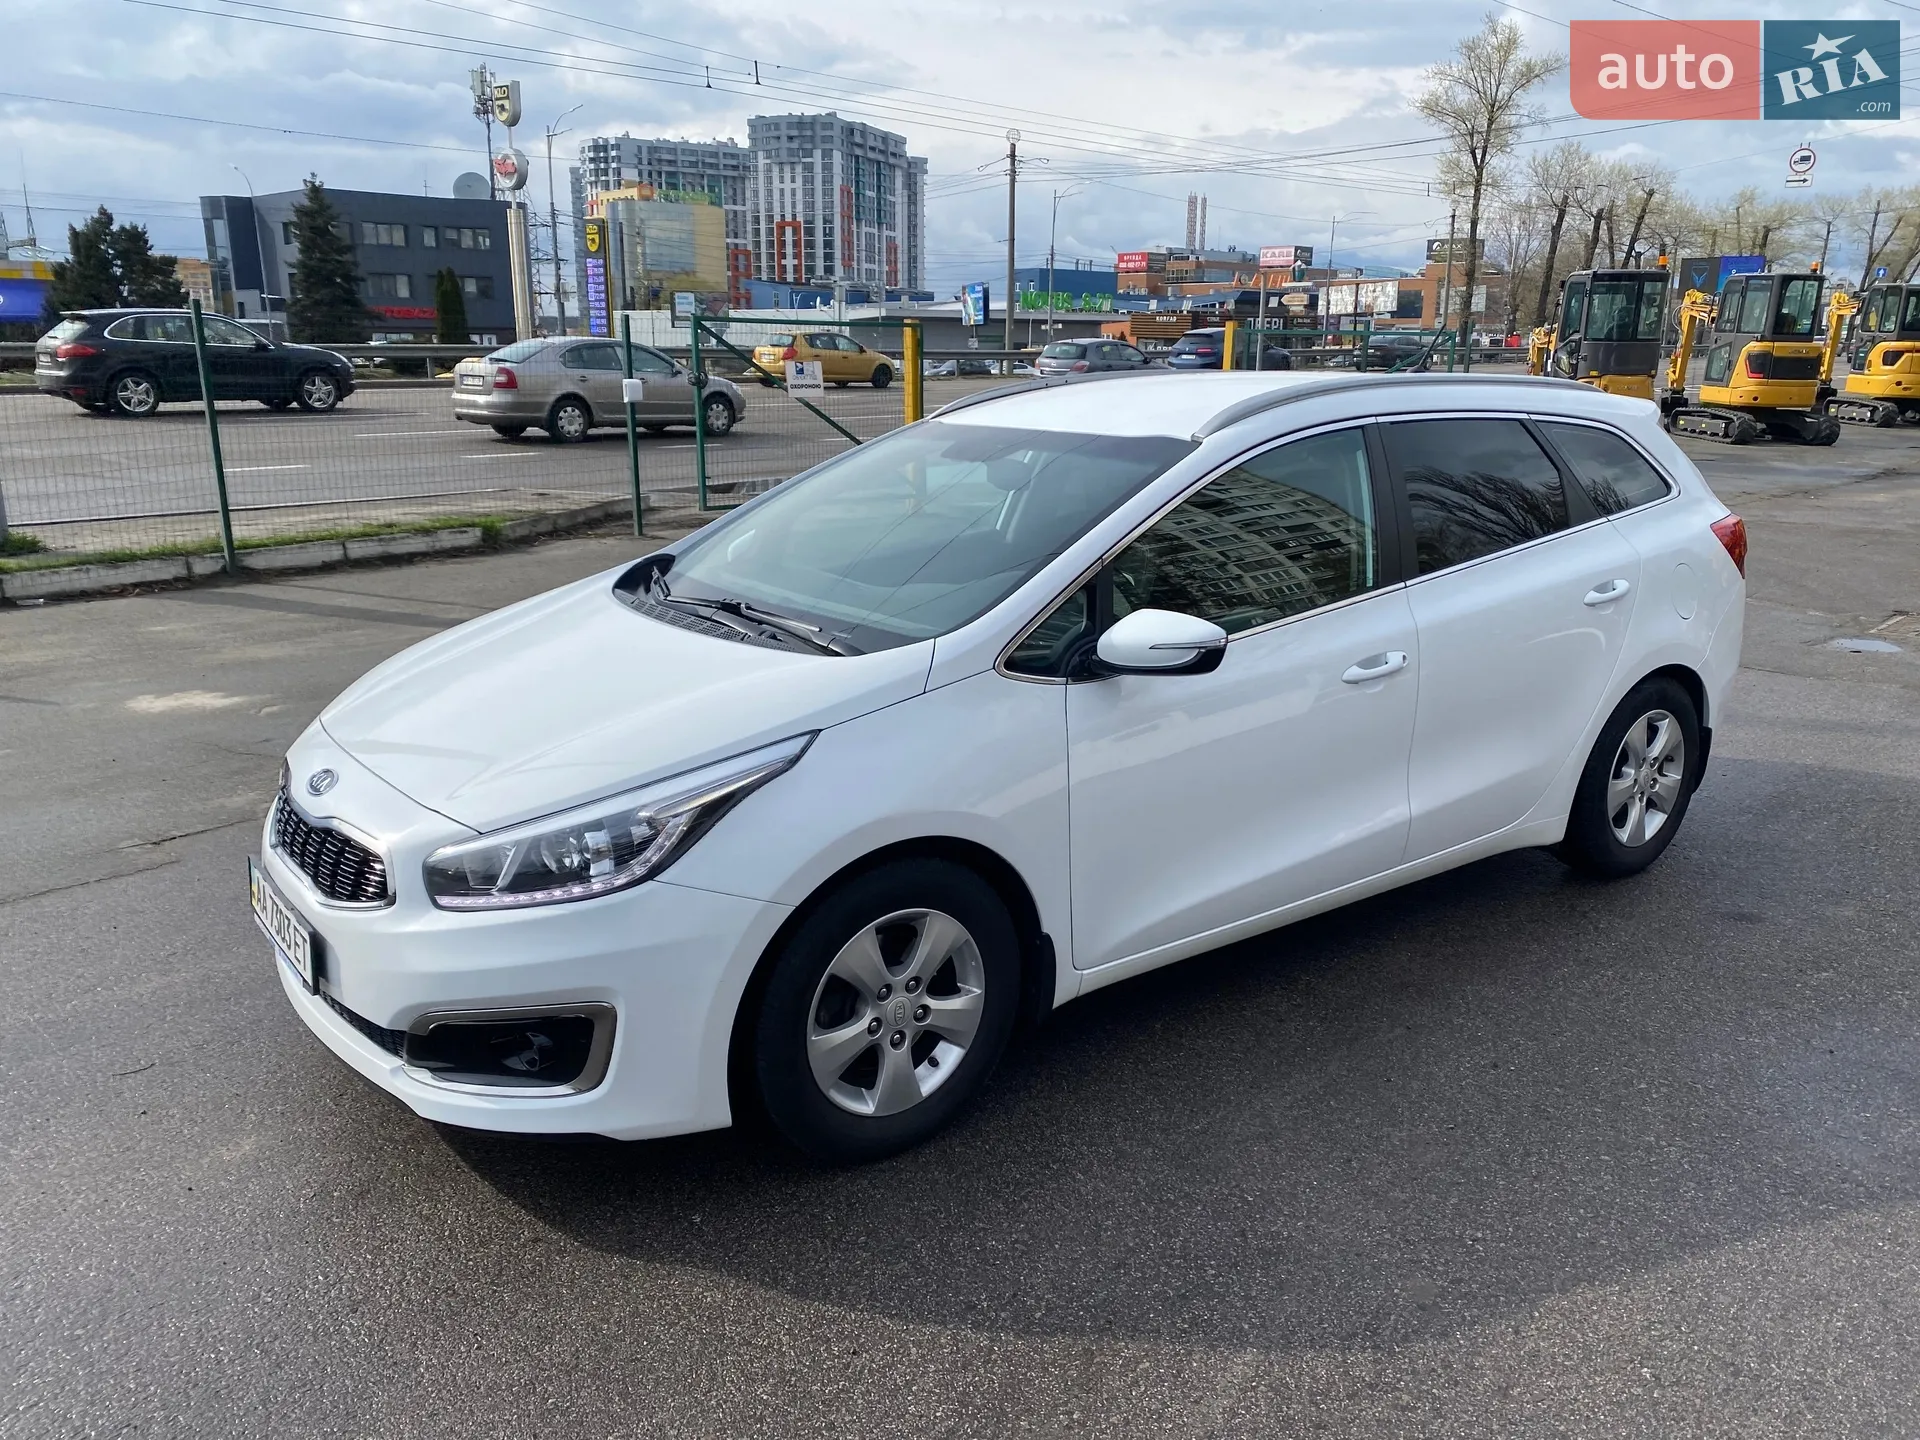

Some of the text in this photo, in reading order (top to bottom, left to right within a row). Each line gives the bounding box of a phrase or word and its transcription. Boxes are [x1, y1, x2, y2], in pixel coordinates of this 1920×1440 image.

[1262, 250, 1294, 259] KARE
[257, 876, 308, 973] AA 7303 ET
